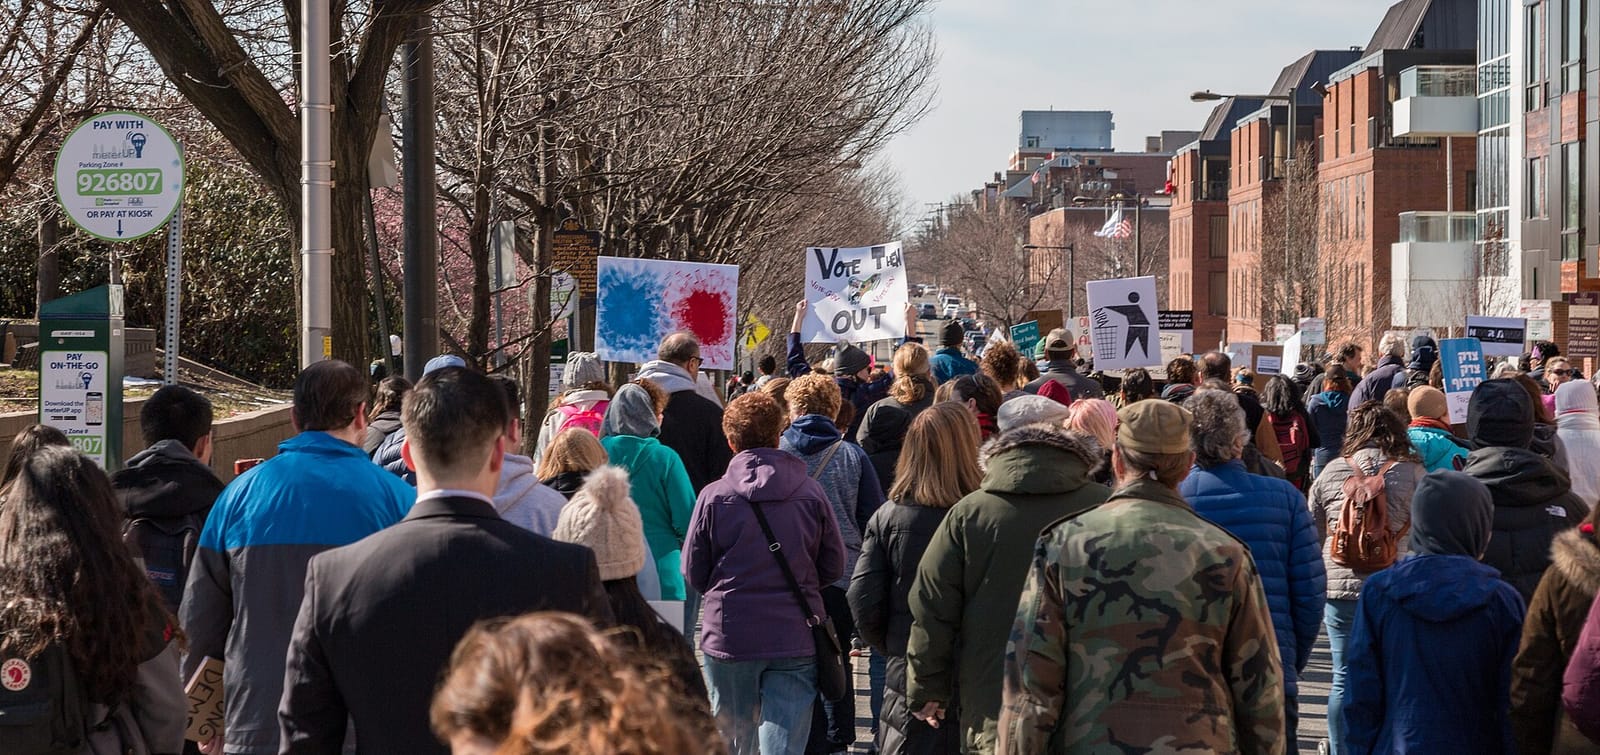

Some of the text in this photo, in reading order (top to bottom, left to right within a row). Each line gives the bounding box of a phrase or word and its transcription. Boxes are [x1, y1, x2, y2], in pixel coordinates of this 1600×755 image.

[93, 120, 144, 130] PAY WITH
[78, 172, 161, 192] 926807
[116, 210, 127, 218] AT
[128, 210, 153, 218] KIOSK
[831, 305, 887, 335] OUT
[1091, 308, 1109, 328] NRA
[66, 353, 83, 361] PAY
[1457, 351, 1479, 364] צדק
[50, 362, 99, 370] ON-THE-GO
[1459, 364, 1482, 377] צדק
[1452, 377, 1482, 391] תרדוף
[68, 437, 102, 453] 807
